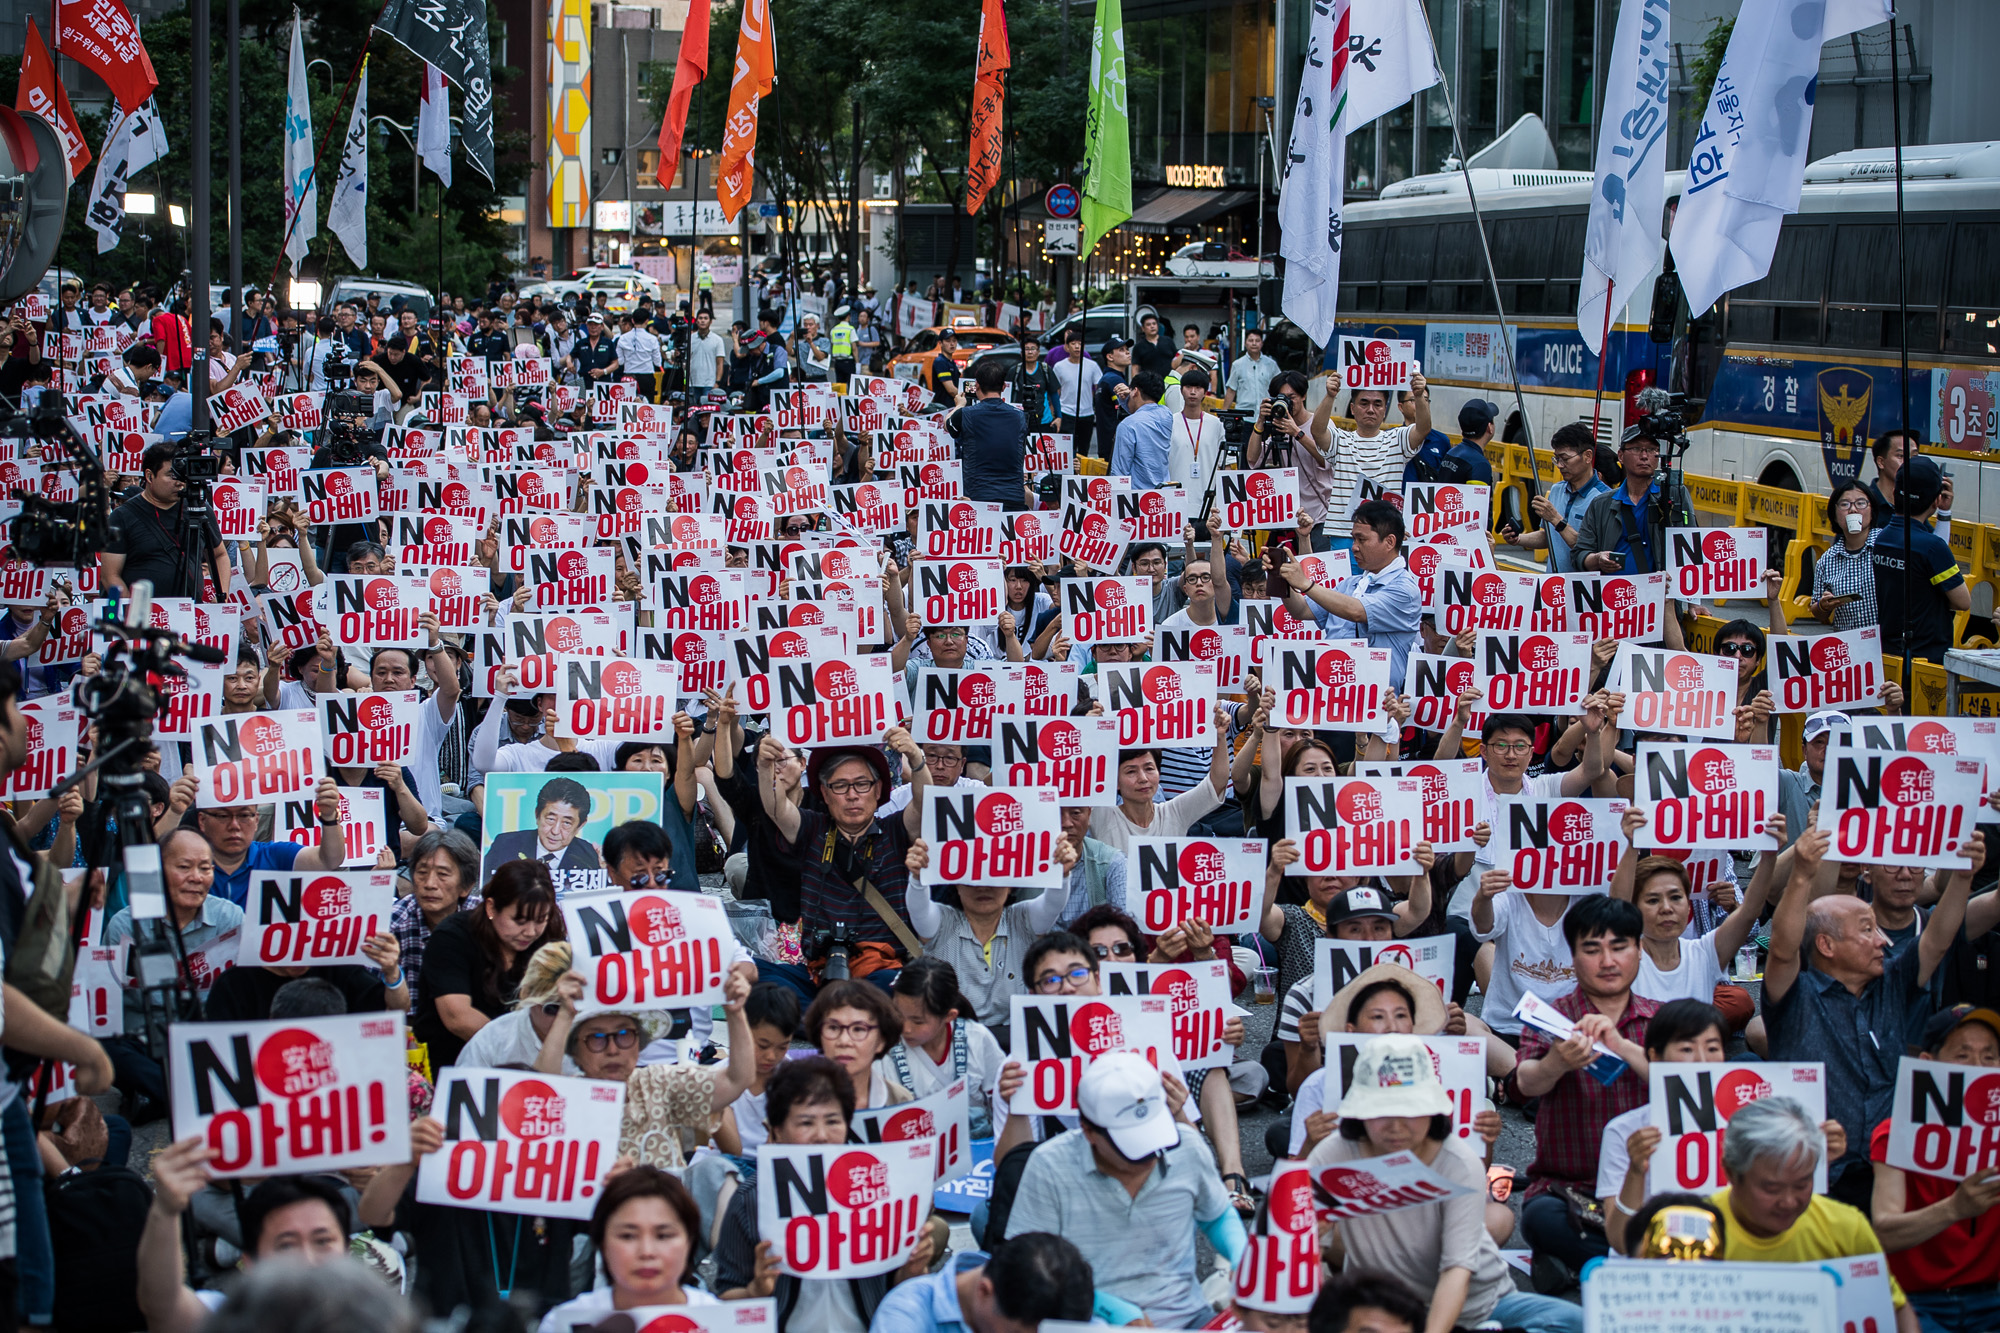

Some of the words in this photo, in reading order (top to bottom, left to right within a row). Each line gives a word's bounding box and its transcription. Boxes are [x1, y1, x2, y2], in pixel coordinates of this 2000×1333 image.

[62, 26, 112, 65] 원구위원회
[83, 12, 135, 64] 서울시당
[1166, 165, 1193, 187] WOOD
[1195, 164, 1226, 188] BRICK
[1869, 163, 1905, 175] AutoTe
[1544, 343, 1582, 374] POLICE
[1347, 361, 1405, 386] 아베!
[1831, 461, 1855, 477] POLICE
[335, 486, 353, 494] abe
[1256, 488, 1275, 496] abe
[1695, 486, 1721, 504] POLICE
[1722, 490, 1737, 506] LINE
[309, 490, 370, 523] 아베!
[1228, 493, 1292, 527] 아베!
[1760, 497, 1783, 515] POLICE
[1785, 501, 1799, 519] LINE
[928, 527, 992, 555] 아베!
[1714, 550, 1737, 559] abe
[958, 580, 979, 589] abe
[1680, 557, 1756, 595] 아베!
[376, 598, 399, 607] abe
[927, 587, 996, 623] 아베!
[1105, 597, 1126, 606] abe
[340, 606, 418, 643] 아베!
[1074, 604, 1145, 641] 아베!
[1532, 658, 1558, 668] abe
[1824, 656, 1850, 668] abe
[615, 684, 641, 694] abe
[830, 683, 858, 696] abe
[1329, 673, 1355, 683] abe
[1488, 667, 1580, 709] 아베!
[1677, 678, 1703, 688] abe
[1784, 663, 1873, 709] 아베!
[571, 695, 663, 735] 아베!
[1286, 683, 1377, 724] 아베!
[1633, 690, 1725, 727] 아베!
[370, 717, 393, 726] abe
[787, 692, 884, 743] 아베!
[256, 739, 285, 753] abe
[333, 724, 411, 765] 아베!
[213, 747, 313, 802] 아베!
[1704, 777, 1736, 791] abe
[1898, 789, 1933, 802] abe
[991, 820, 1023, 832] abe
[1352, 808, 1383, 821] abe
[1655, 789, 1763, 843] 아베!
[1563, 829, 1593, 841] abe
[1837, 803, 1963, 856] 아베!
[940, 830, 1050, 880] 아베!
[1305, 818, 1409, 871] 아베!
[1513, 840, 1618, 889] 아베!
[648, 926, 686, 943] abe
[596, 937, 722, 1006] 아베!
[285, 1067, 338, 1092] abe
[207, 1080, 385, 1173] 아베!
[521, 1119, 564, 1135] abe
[446, 1139, 600, 1201] 아베!
